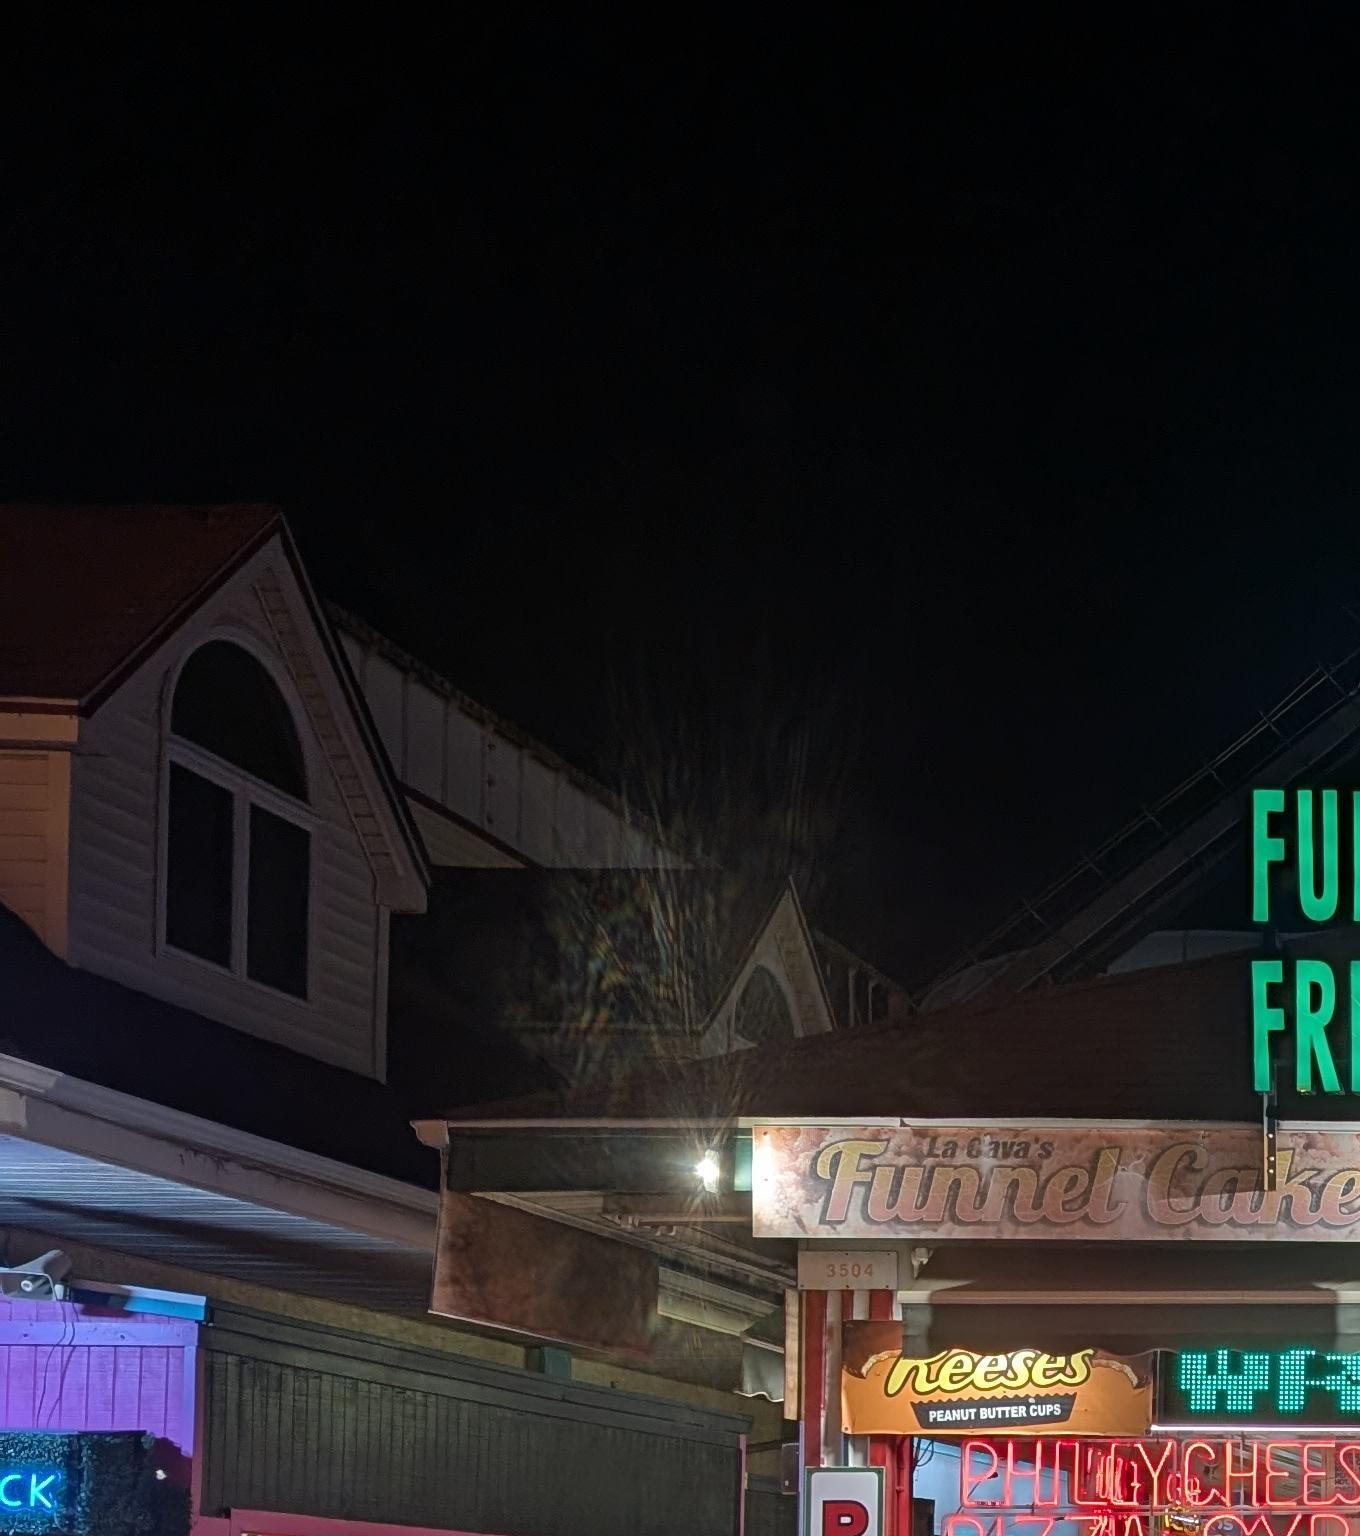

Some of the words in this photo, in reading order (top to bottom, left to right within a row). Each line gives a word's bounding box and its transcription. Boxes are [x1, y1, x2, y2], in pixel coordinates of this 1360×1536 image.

[923, 1134, 958, 1159] La
[965, 1135, 1053, 1161] Cava's
[816, 1137, 1123, 1225] Funnel
[825, 1262, 875, 1279] 3504
[928, 1407, 976, 1423] PEANUT
[979, 1405, 1027, 1420] BUTTER
[1029, 1403, 1062, 1418] CUPS
